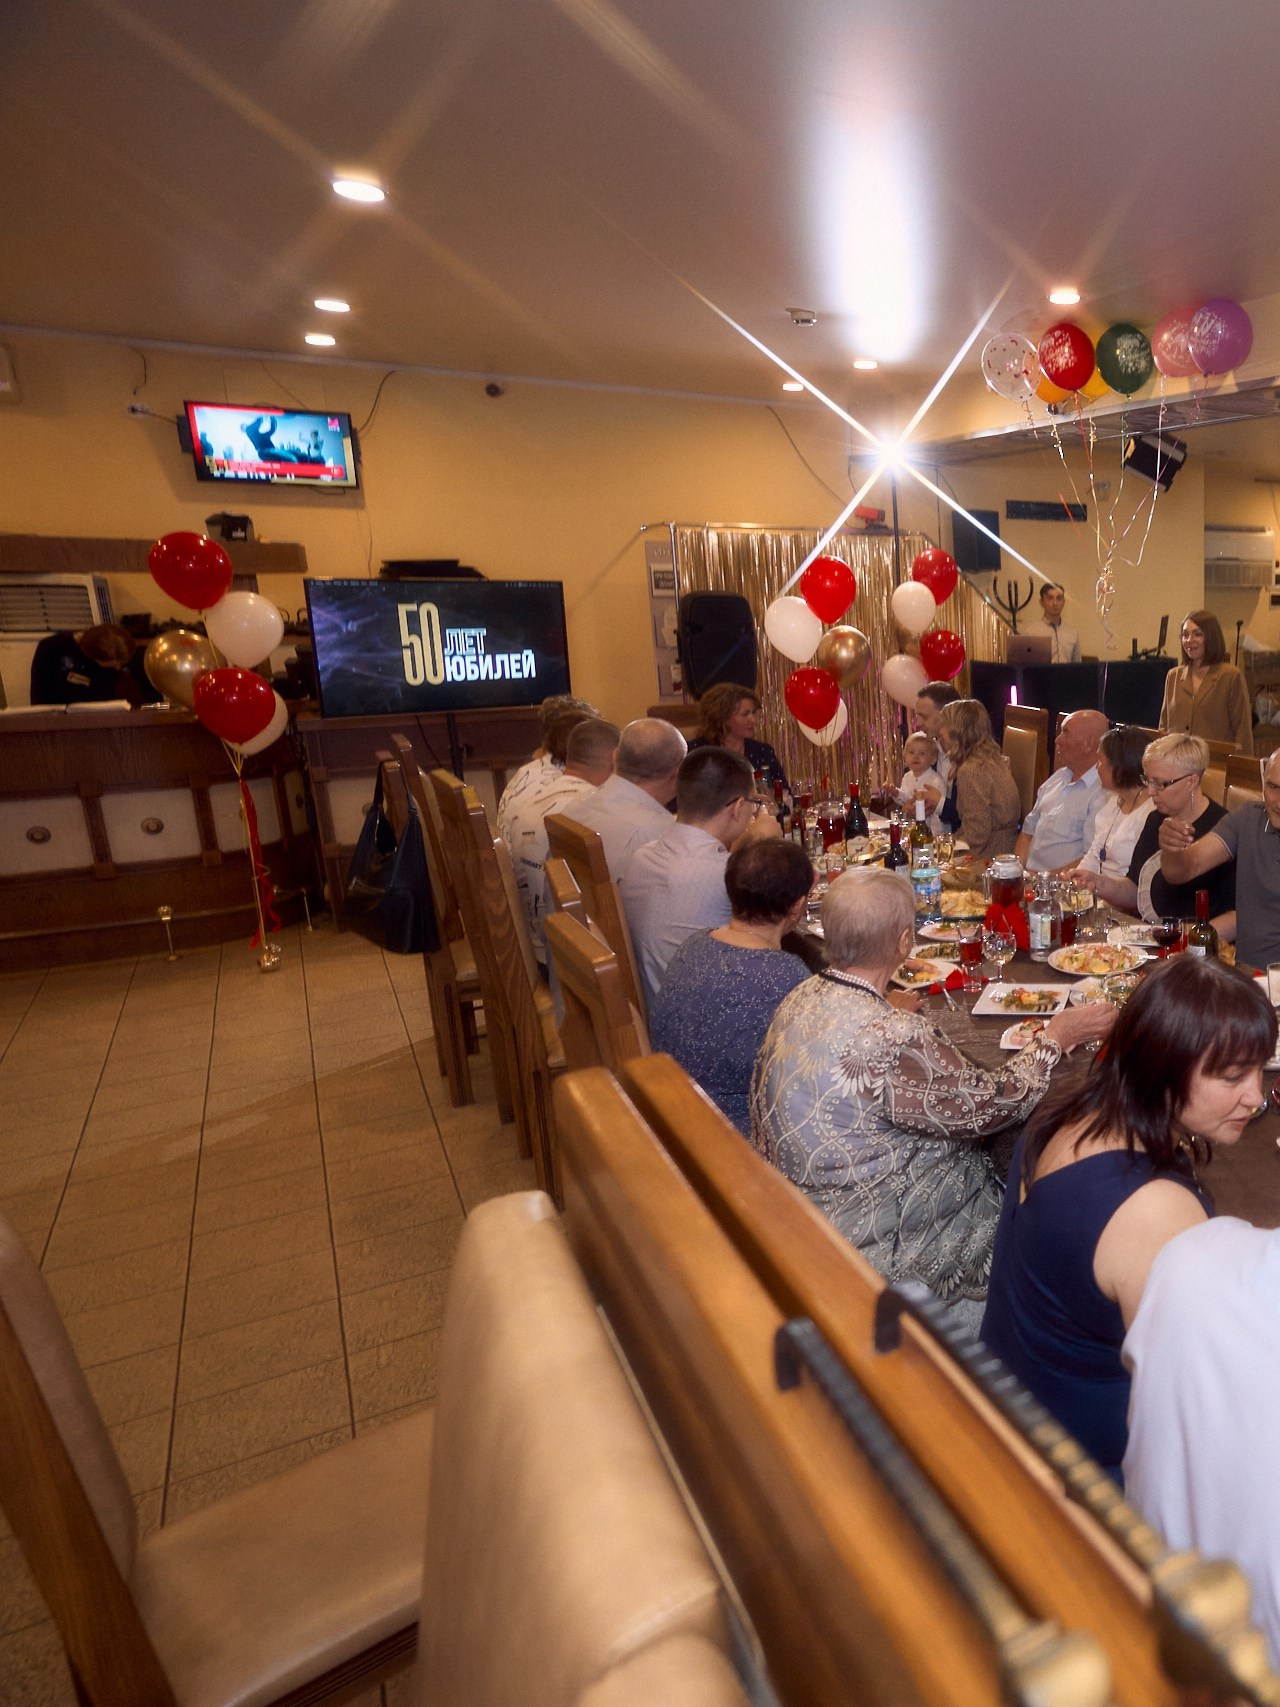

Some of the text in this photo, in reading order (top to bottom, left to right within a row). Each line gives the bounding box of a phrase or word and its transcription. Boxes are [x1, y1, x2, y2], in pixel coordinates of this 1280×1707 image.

[398, 602, 486, 686] 50 ЛЕТ
[445, 649, 536, 682] ЮБИЛЕЙ
